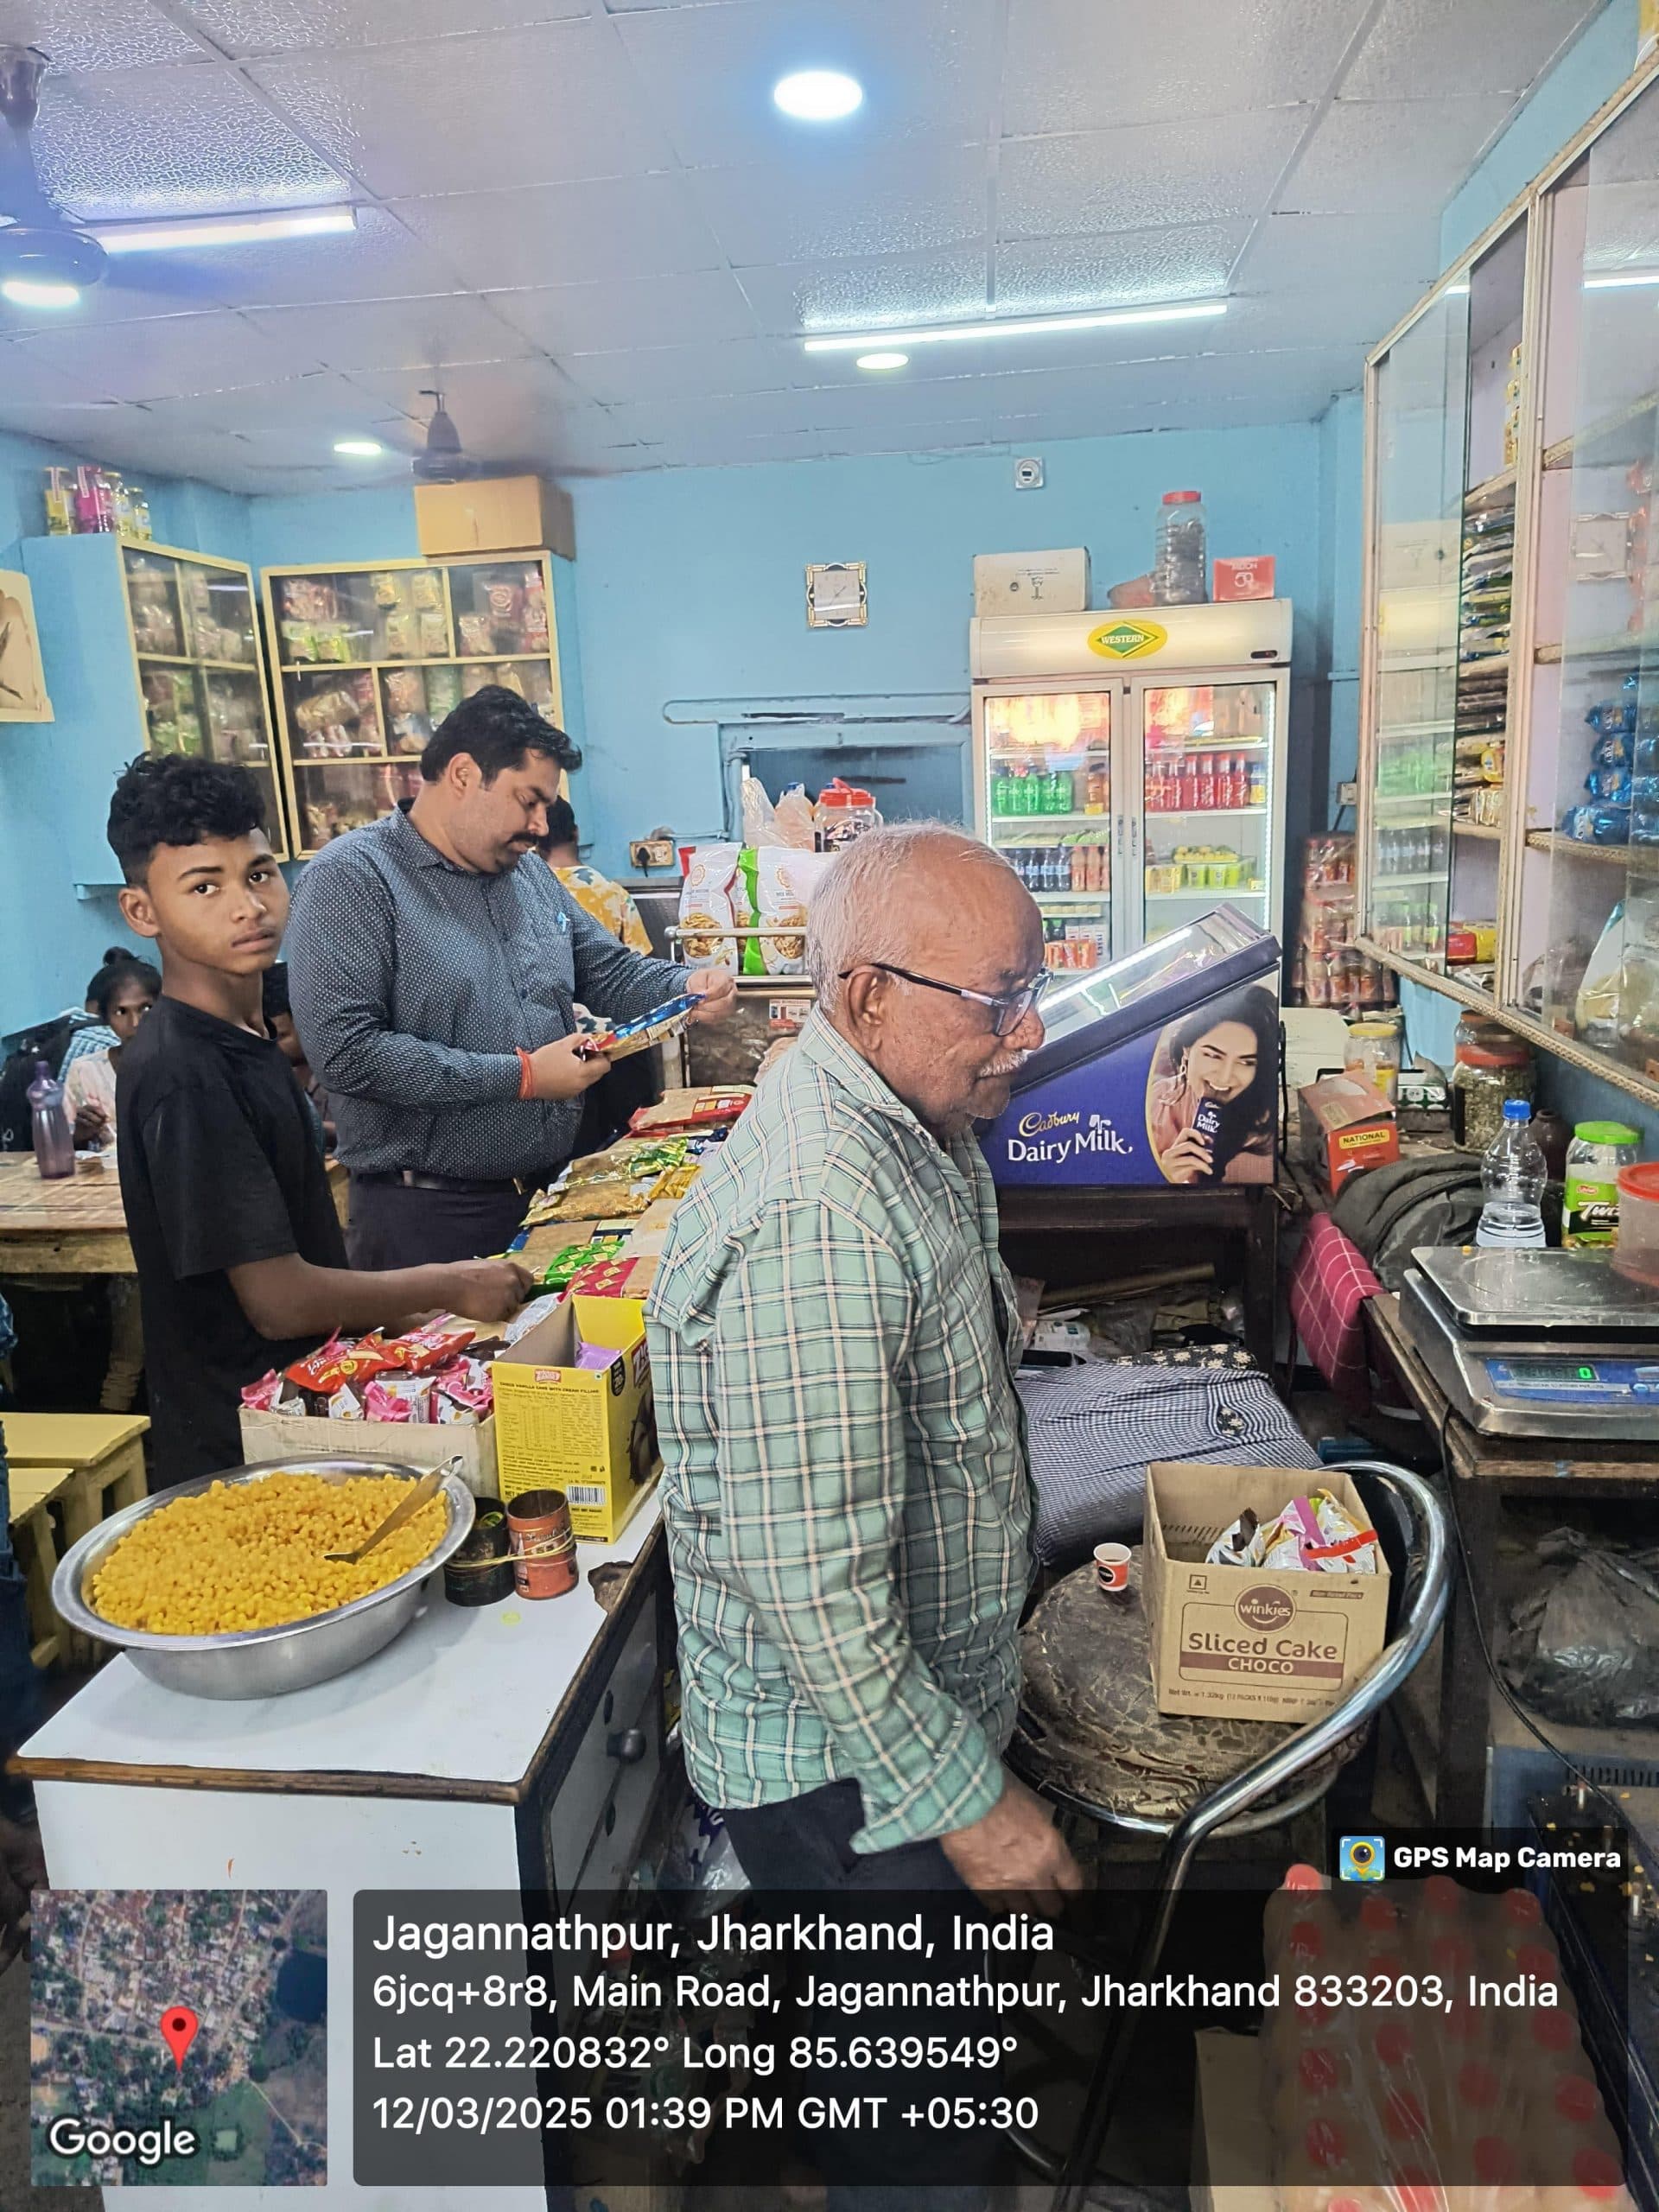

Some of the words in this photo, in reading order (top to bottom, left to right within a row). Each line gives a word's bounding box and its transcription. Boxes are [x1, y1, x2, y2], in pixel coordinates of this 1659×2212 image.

[1101, 634, 1144, 645] WESTERN
[1019, 1111, 1080, 1138] Cadbury
[1007, 1139, 1071, 1164] Dairy
[1075, 1128, 1131, 1155] Milk
[1343, 1131, 1386, 1144] NATIONAL
[1240, 1599, 1291, 1618] winkies
[1188, 1632, 1268, 1656] Sliced
[1275, 1639, 1338, 1660] Cake
[1228, 1657, 1294, 1675] CHOCO
